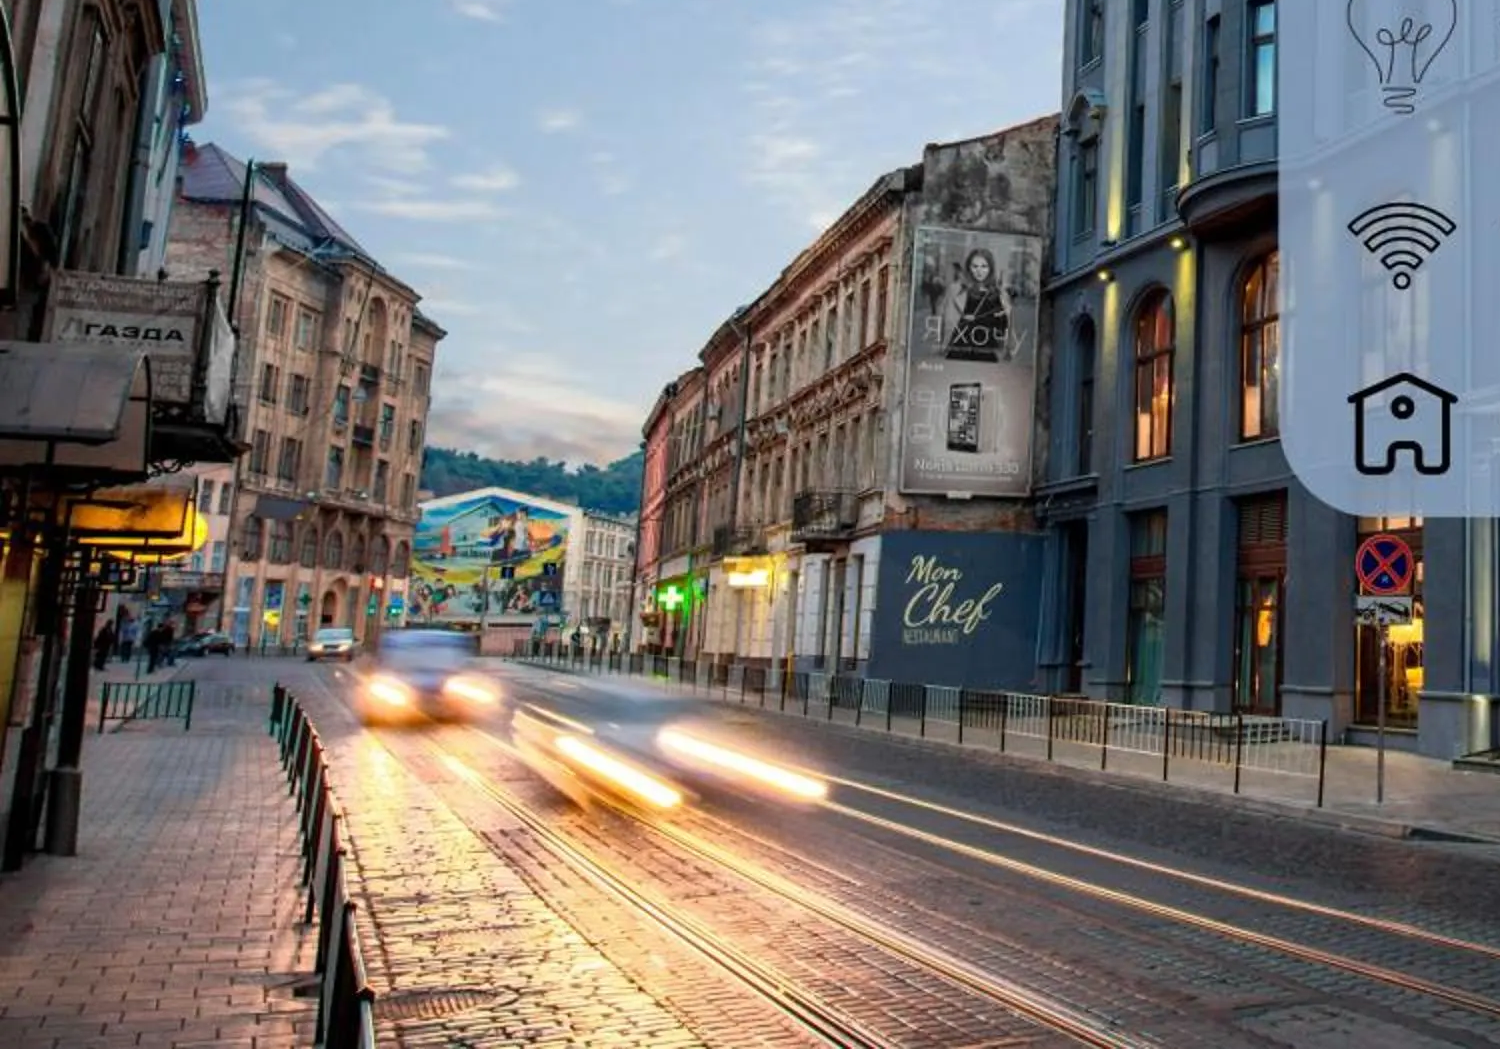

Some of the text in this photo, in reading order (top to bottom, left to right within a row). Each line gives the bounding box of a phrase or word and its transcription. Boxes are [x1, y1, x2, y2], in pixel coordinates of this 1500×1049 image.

[84, 323, 185, 342] ГАЗДА
[923, 314, 1029, 356] Я хочу
[905, 554, 963, 584] Mon
[904, 582, 1003, 635] Chef
